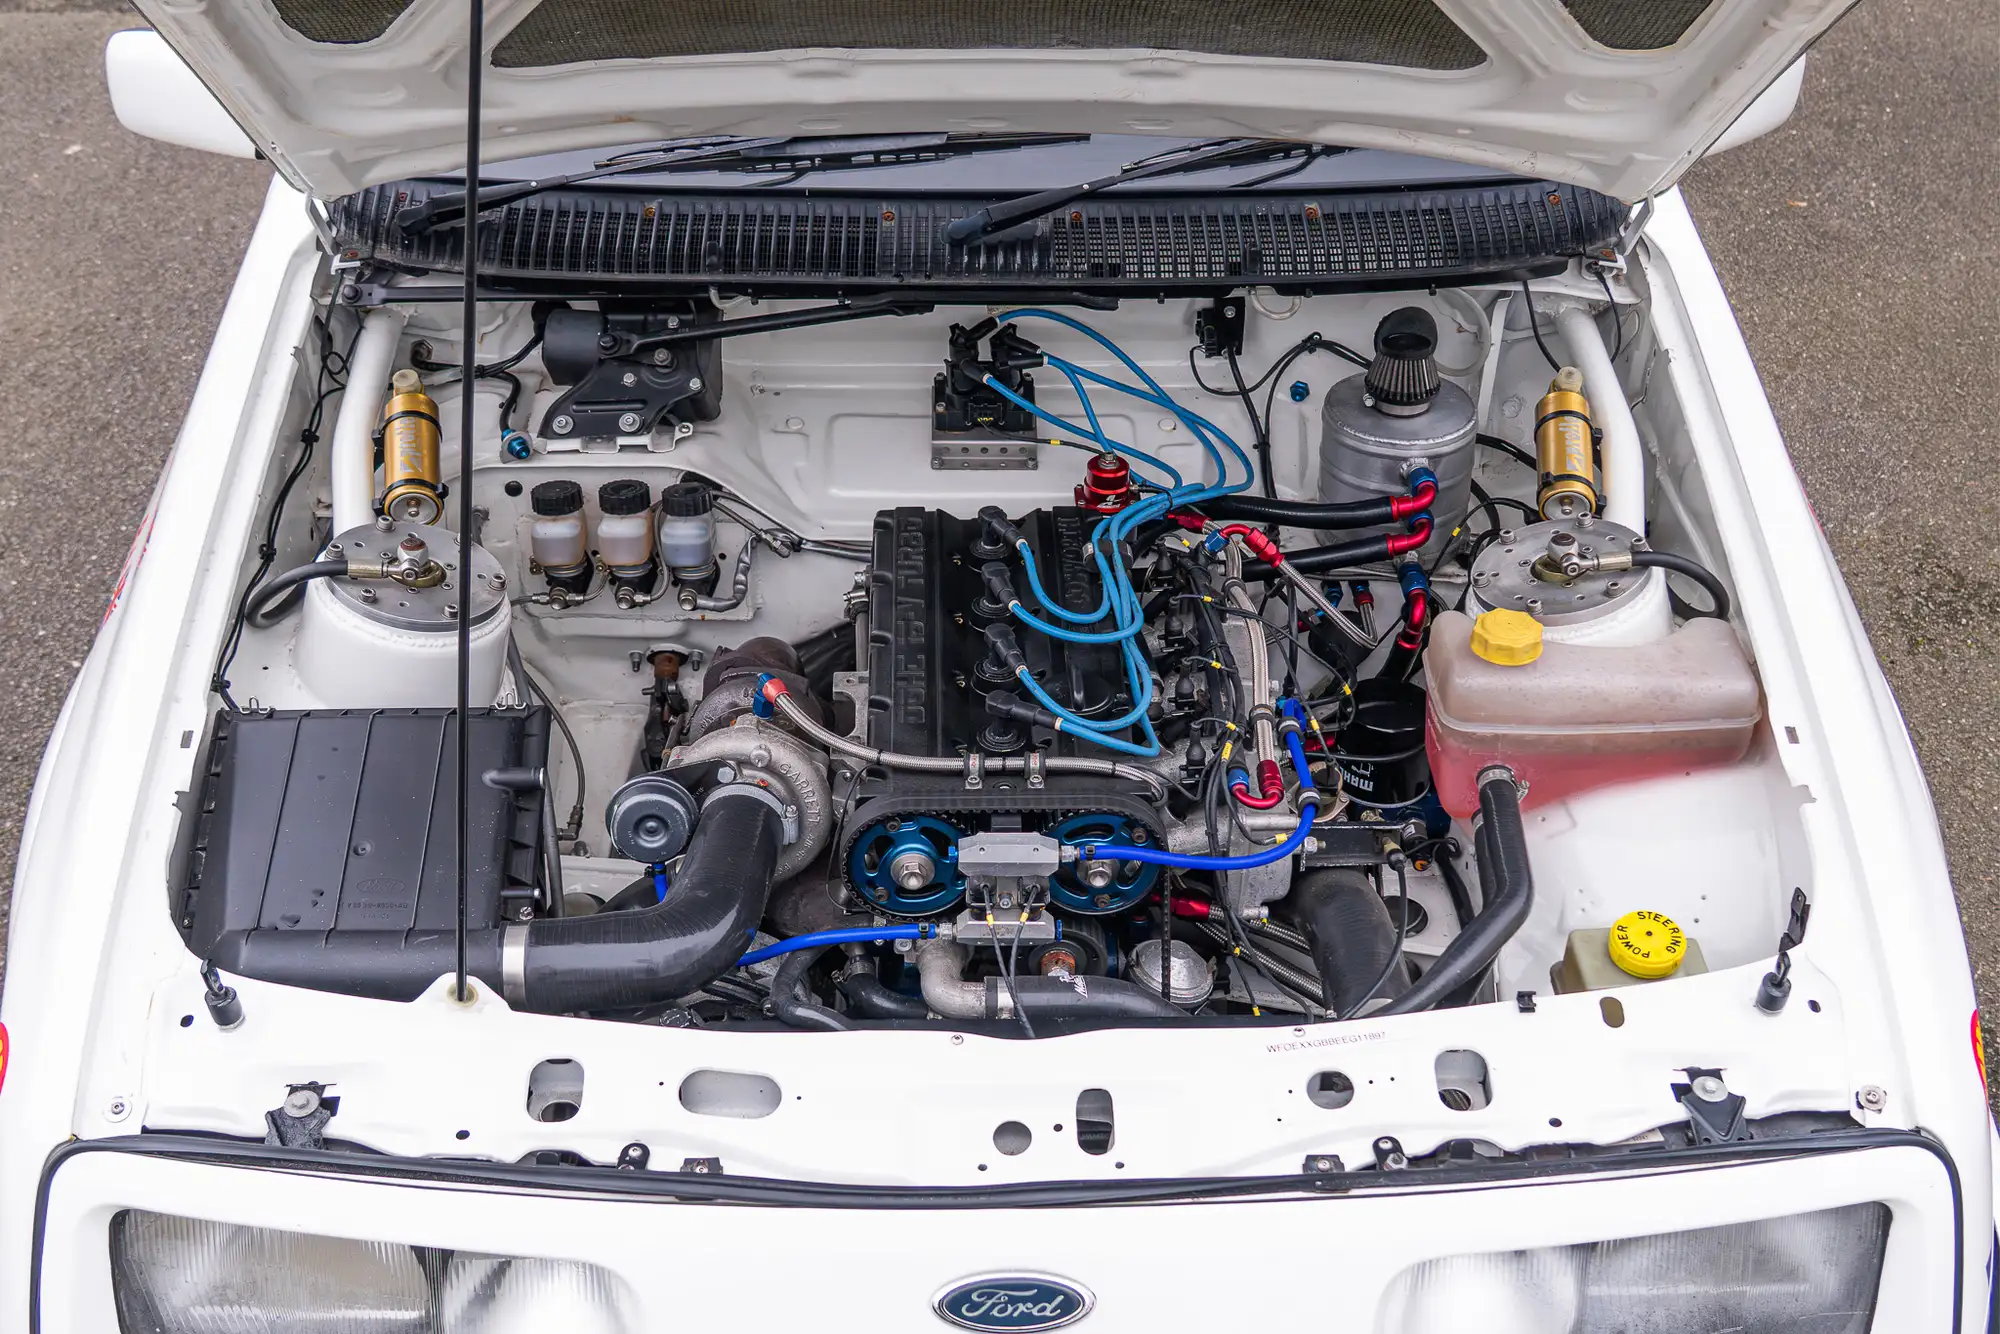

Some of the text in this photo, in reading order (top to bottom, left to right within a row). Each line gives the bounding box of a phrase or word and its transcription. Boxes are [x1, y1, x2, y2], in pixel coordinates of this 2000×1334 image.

[778, 762, 822, 824] GARRETT
[1339, 764, 1374, 793] MAHL
[1616, 910, 1682, 959] POWER STEERING
[961, 1288, 1065, 1318] Ford
